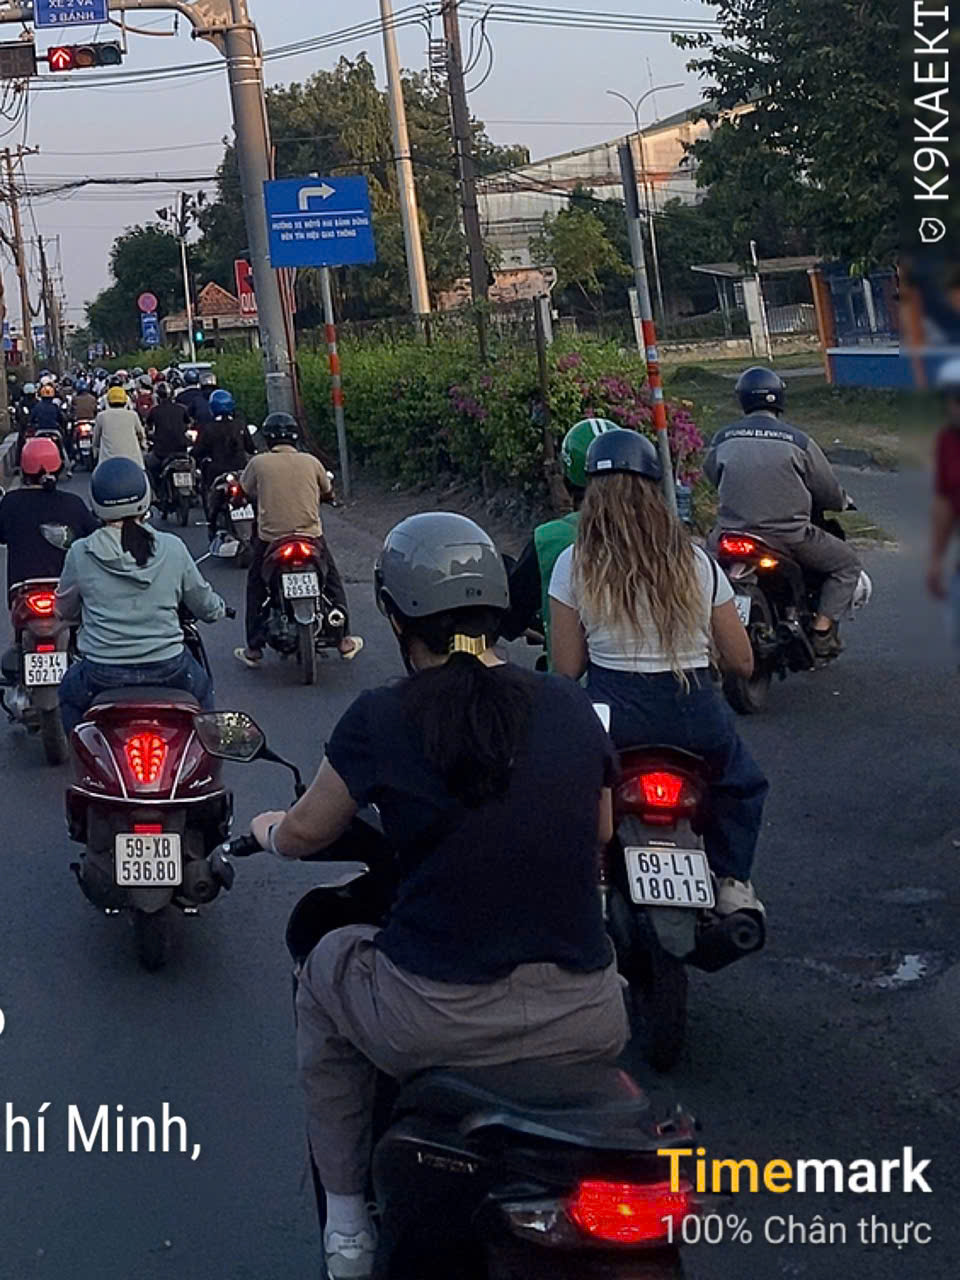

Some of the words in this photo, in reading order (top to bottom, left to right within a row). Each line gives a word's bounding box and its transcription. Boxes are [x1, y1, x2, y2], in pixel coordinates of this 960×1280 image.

[122, 861, 176, 881] 536.80
[638, 852, 694, 876] 69-L1
[636, 876, 707, 902] 180.15
